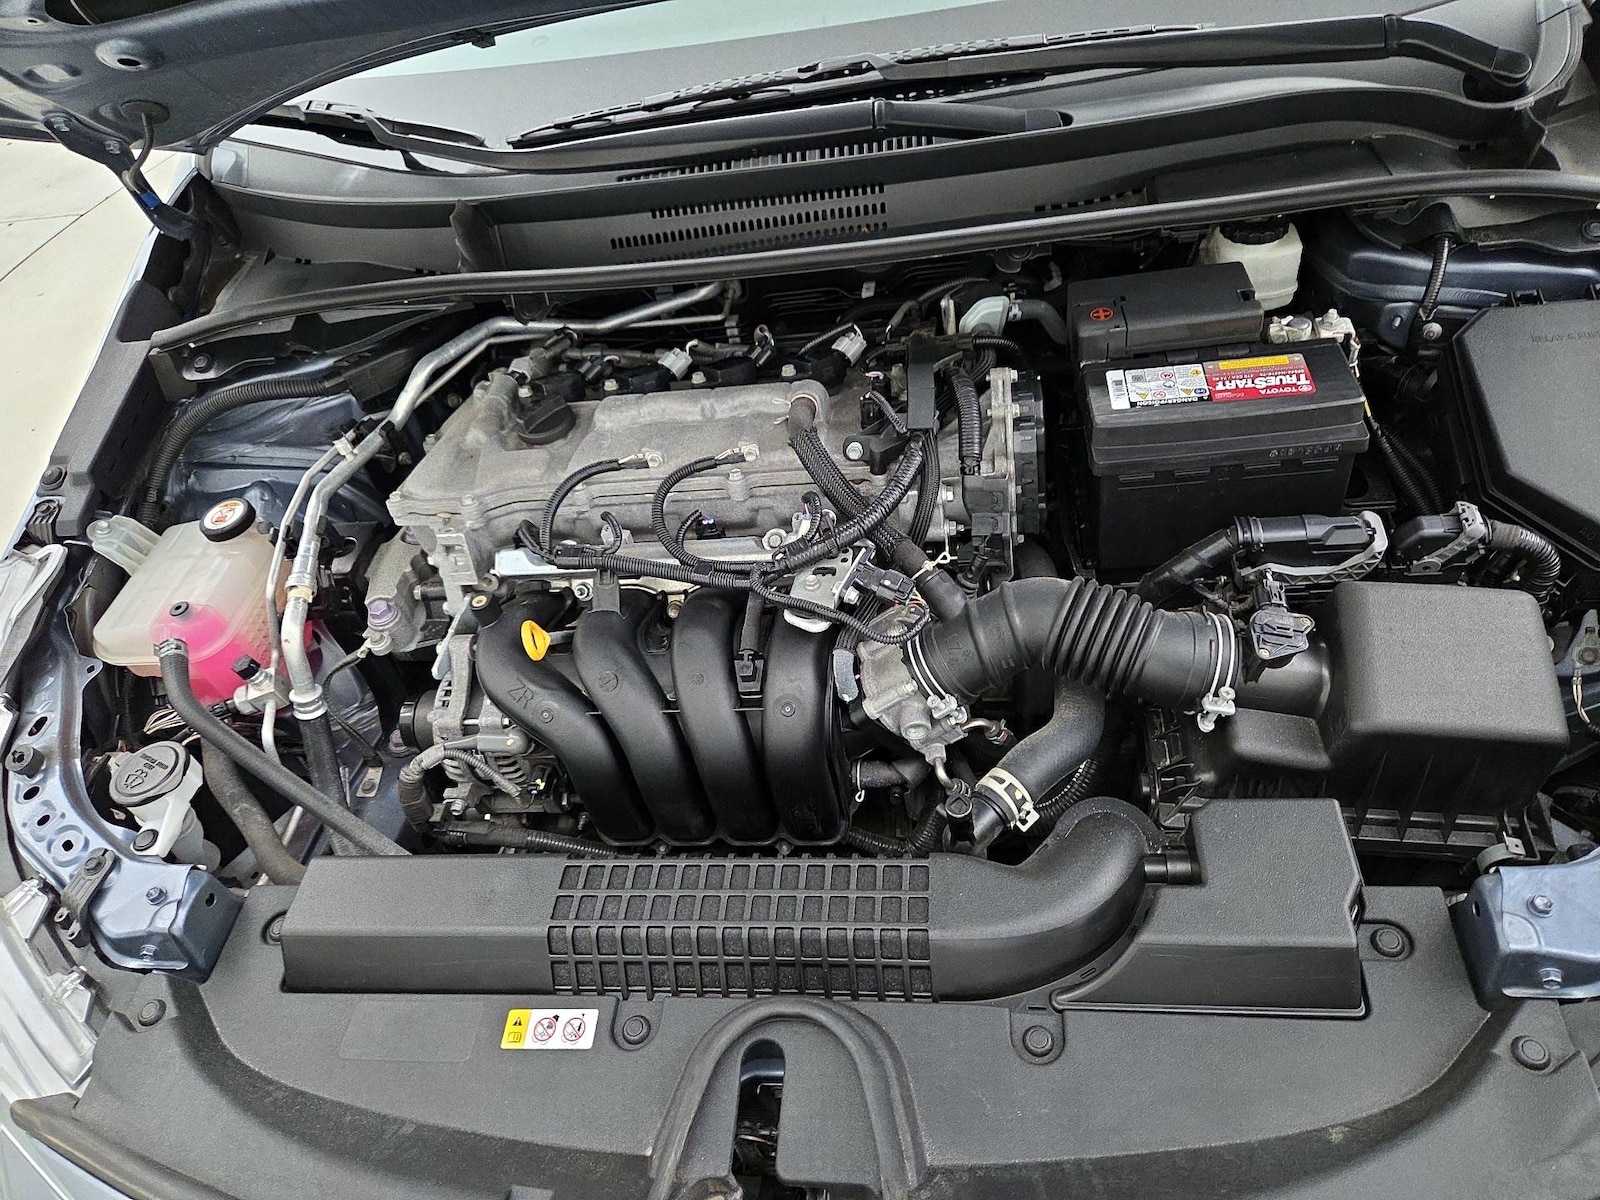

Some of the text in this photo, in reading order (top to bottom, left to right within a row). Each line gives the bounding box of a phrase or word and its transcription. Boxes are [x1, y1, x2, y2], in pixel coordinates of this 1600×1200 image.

[1215, 374, 1311, 391] TRUESTART
[1258, 385, 1297, 395] TOYOTA
[506, 678, 534, 710] ZR
